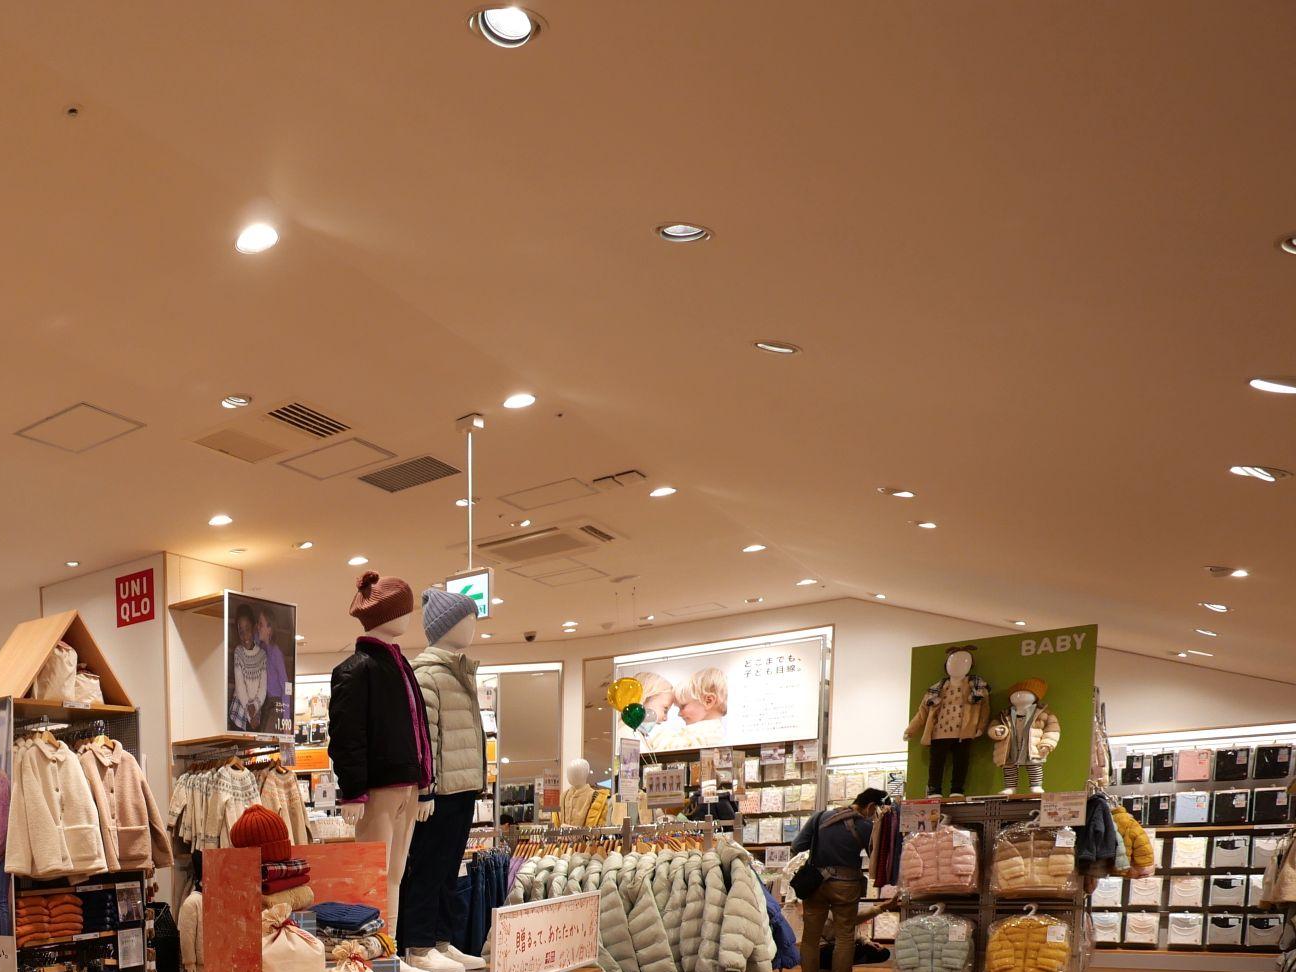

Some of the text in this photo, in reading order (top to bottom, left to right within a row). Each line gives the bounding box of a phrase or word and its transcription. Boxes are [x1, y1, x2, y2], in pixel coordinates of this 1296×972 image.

[119, 577, 147, 599] UNI
[120, 597, 151, 622] QLO
[1021, 632, 1086, 656] BABY
[744, 654, 802, 668] どこまでも、
[744, 665, 801, 678] 子ども目線。
